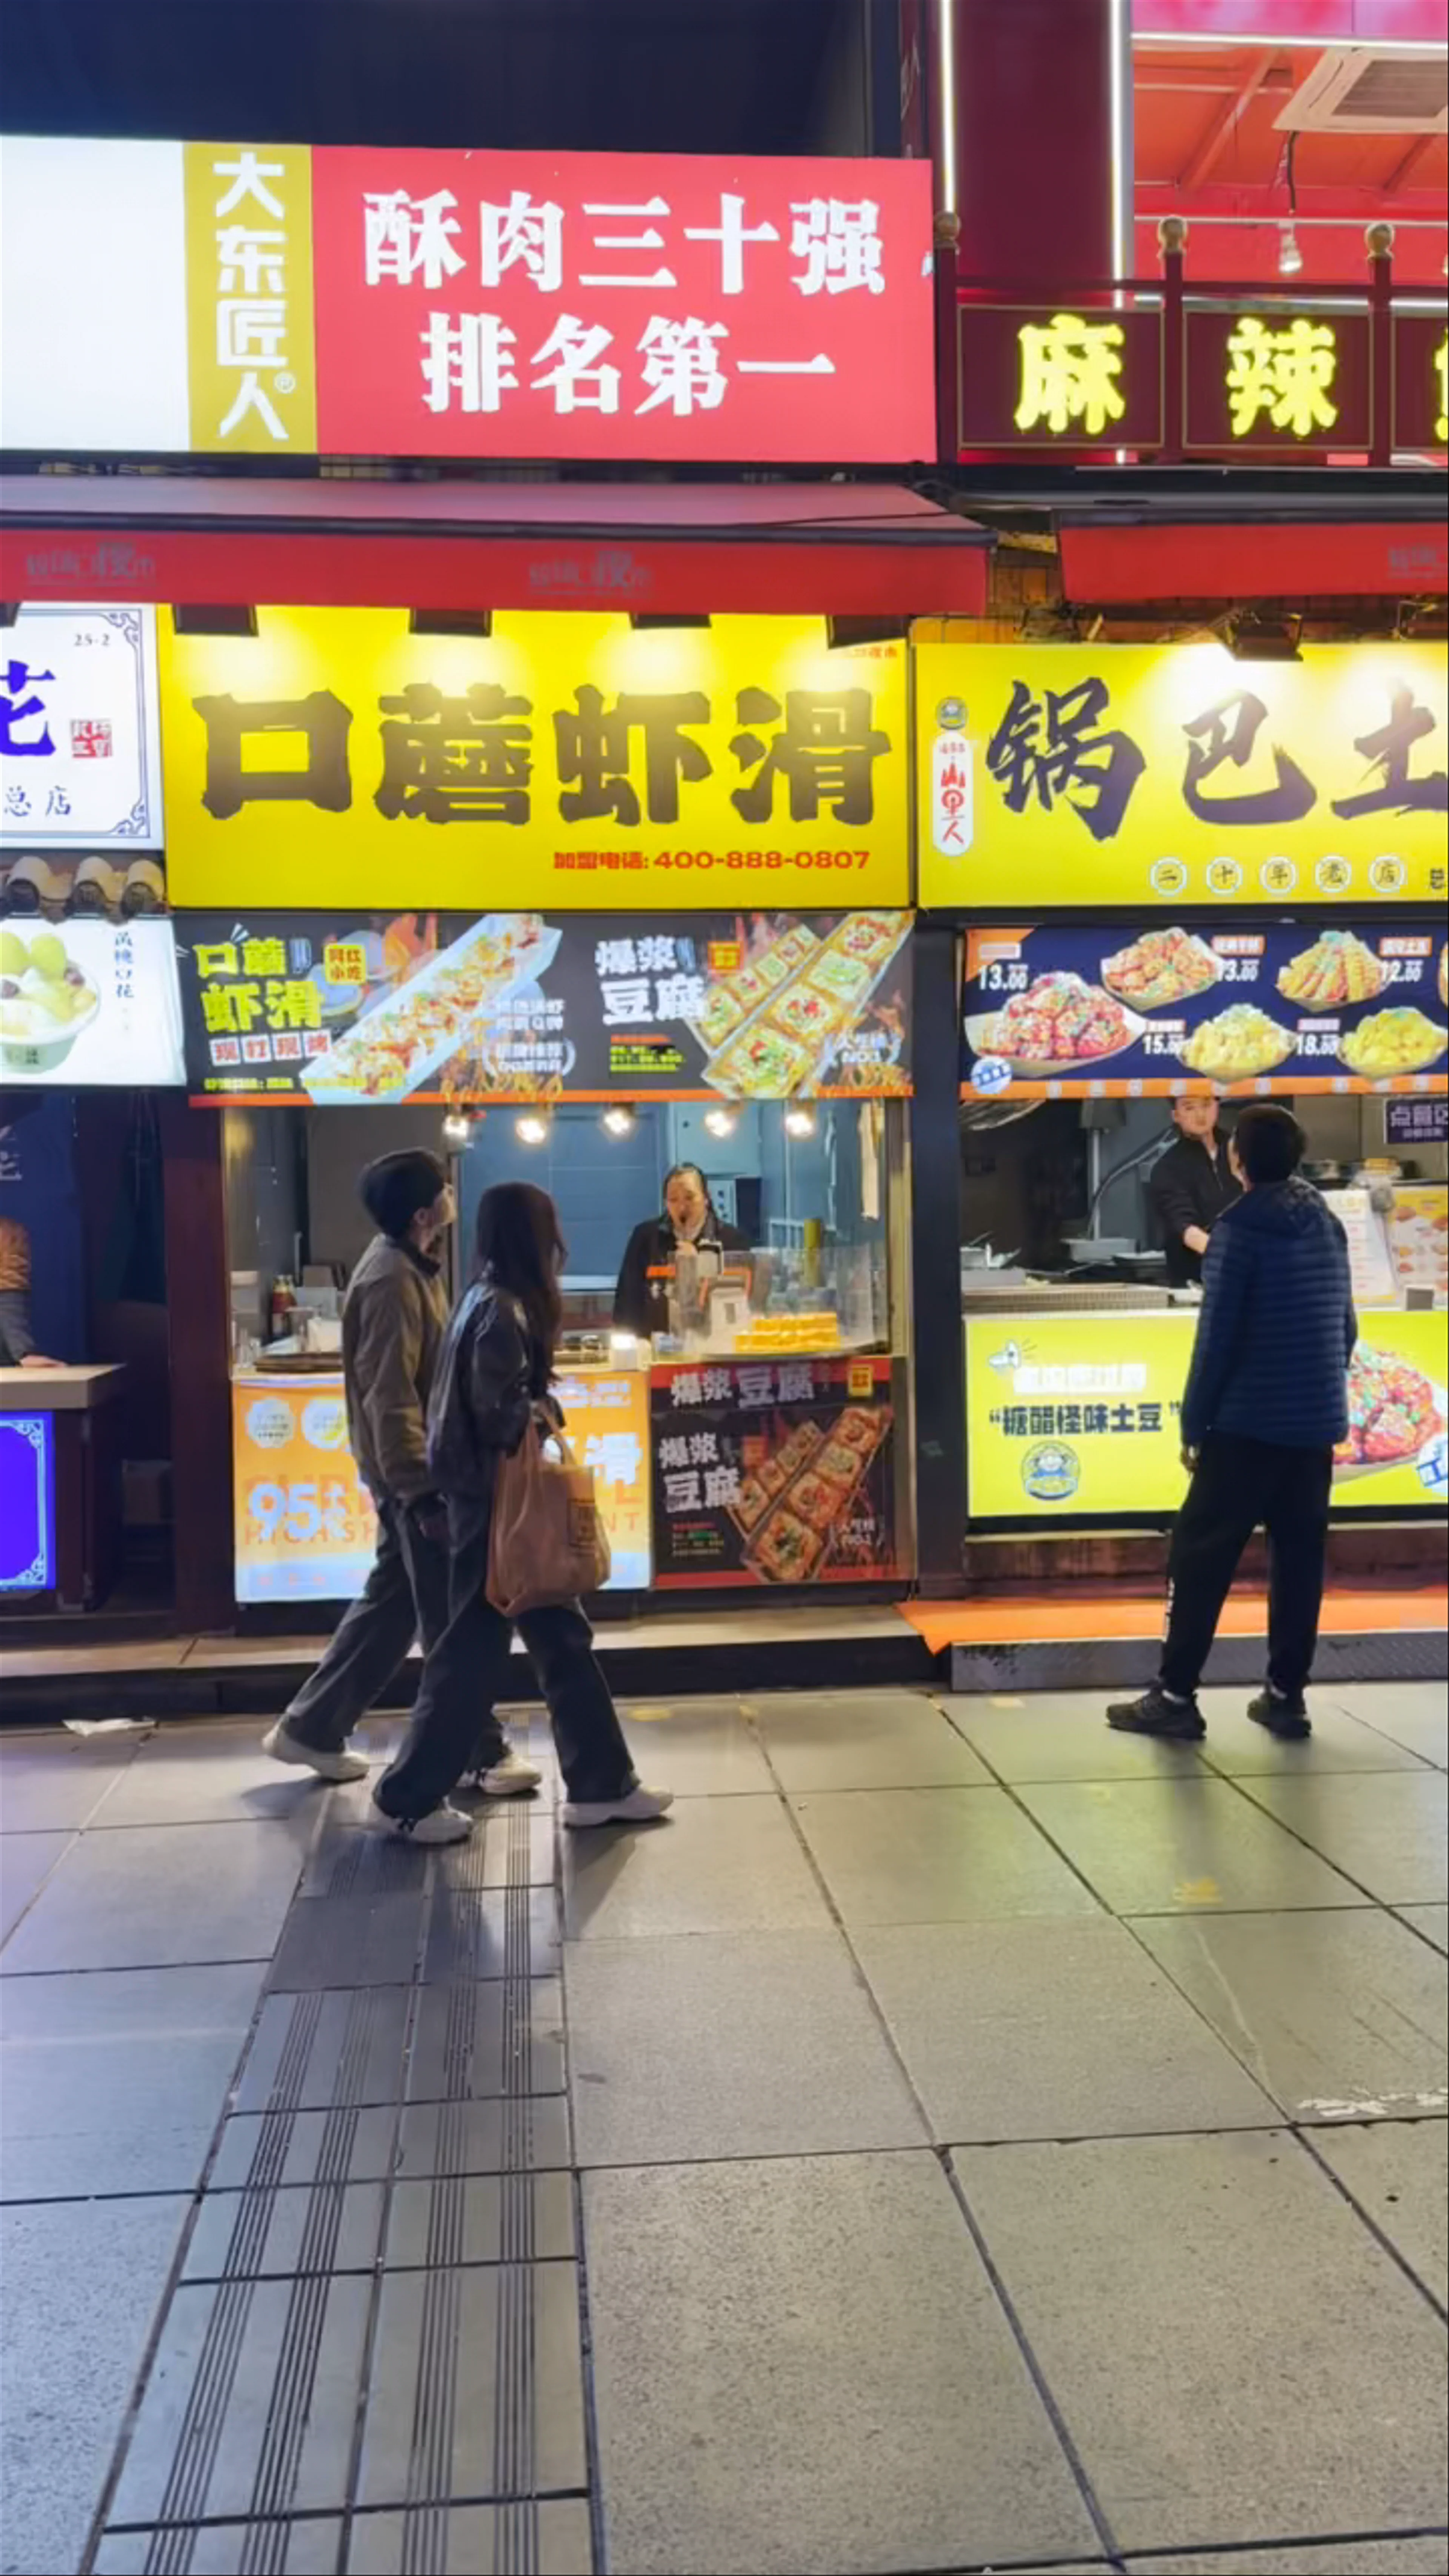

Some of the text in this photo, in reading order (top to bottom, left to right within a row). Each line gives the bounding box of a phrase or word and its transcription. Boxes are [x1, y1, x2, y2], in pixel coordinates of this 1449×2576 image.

[362, 188, 887, 296] 酥肉三十强
[212, 151, 289, 441] 大东匠人
[419, 311, 837, 416] 排名第一
[1014, 314, 1448, 441] 麻辣
[4, 786, 71, 817] 总店
[190, 681, 893, 826] 口蘑虾滑
[985, 676, 1448, 843] 锅巴土
[654, 851, 871, 869] 400-888-0807
[201, 980, 326, 1033] 虾滑
[595, 936, 677, 976] 爆浆
[658, 1432, 718, 1469] 爆浆
